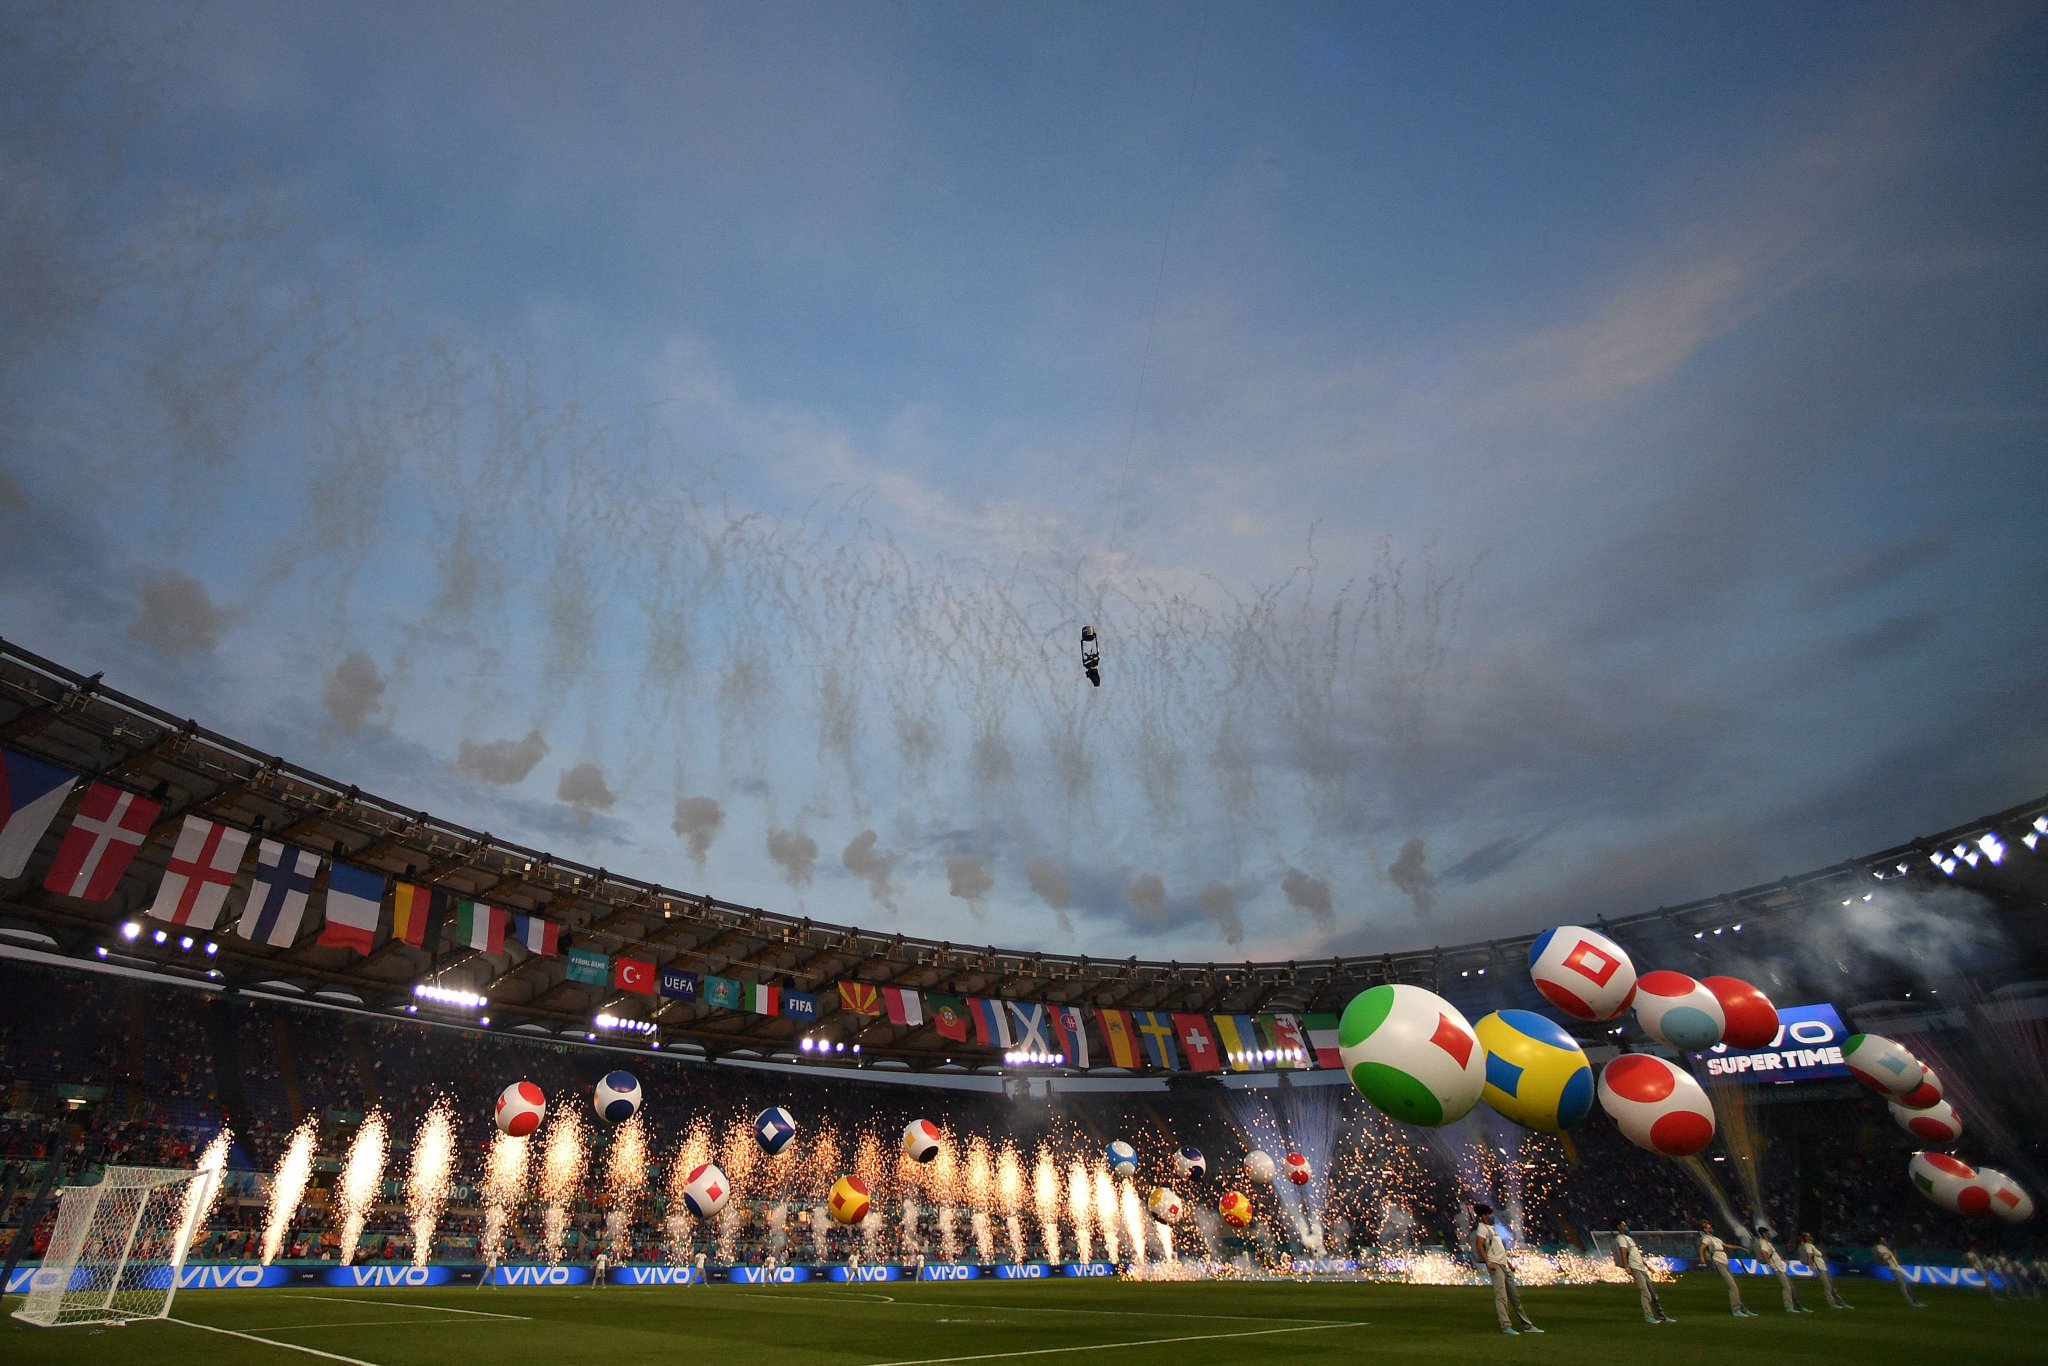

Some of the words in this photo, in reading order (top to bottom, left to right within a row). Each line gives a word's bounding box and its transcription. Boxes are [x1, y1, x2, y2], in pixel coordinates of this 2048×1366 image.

[664, 976, 694, 993] UEFA
[790, 998, 813, 1013] FIFA
[178, 1266, 264, 1287] VIVO
[353, 1266, 429, 1286] VIVO
[504, 1267, 569, 1284] VIVO
[633, 1267, 689, 1284] VIVO
[929, 1266, 968, 1280] VIVO
[1006, 1265, 1040, 1278] VIVO
[1073, 1264, 1104, 1276] VIVO
